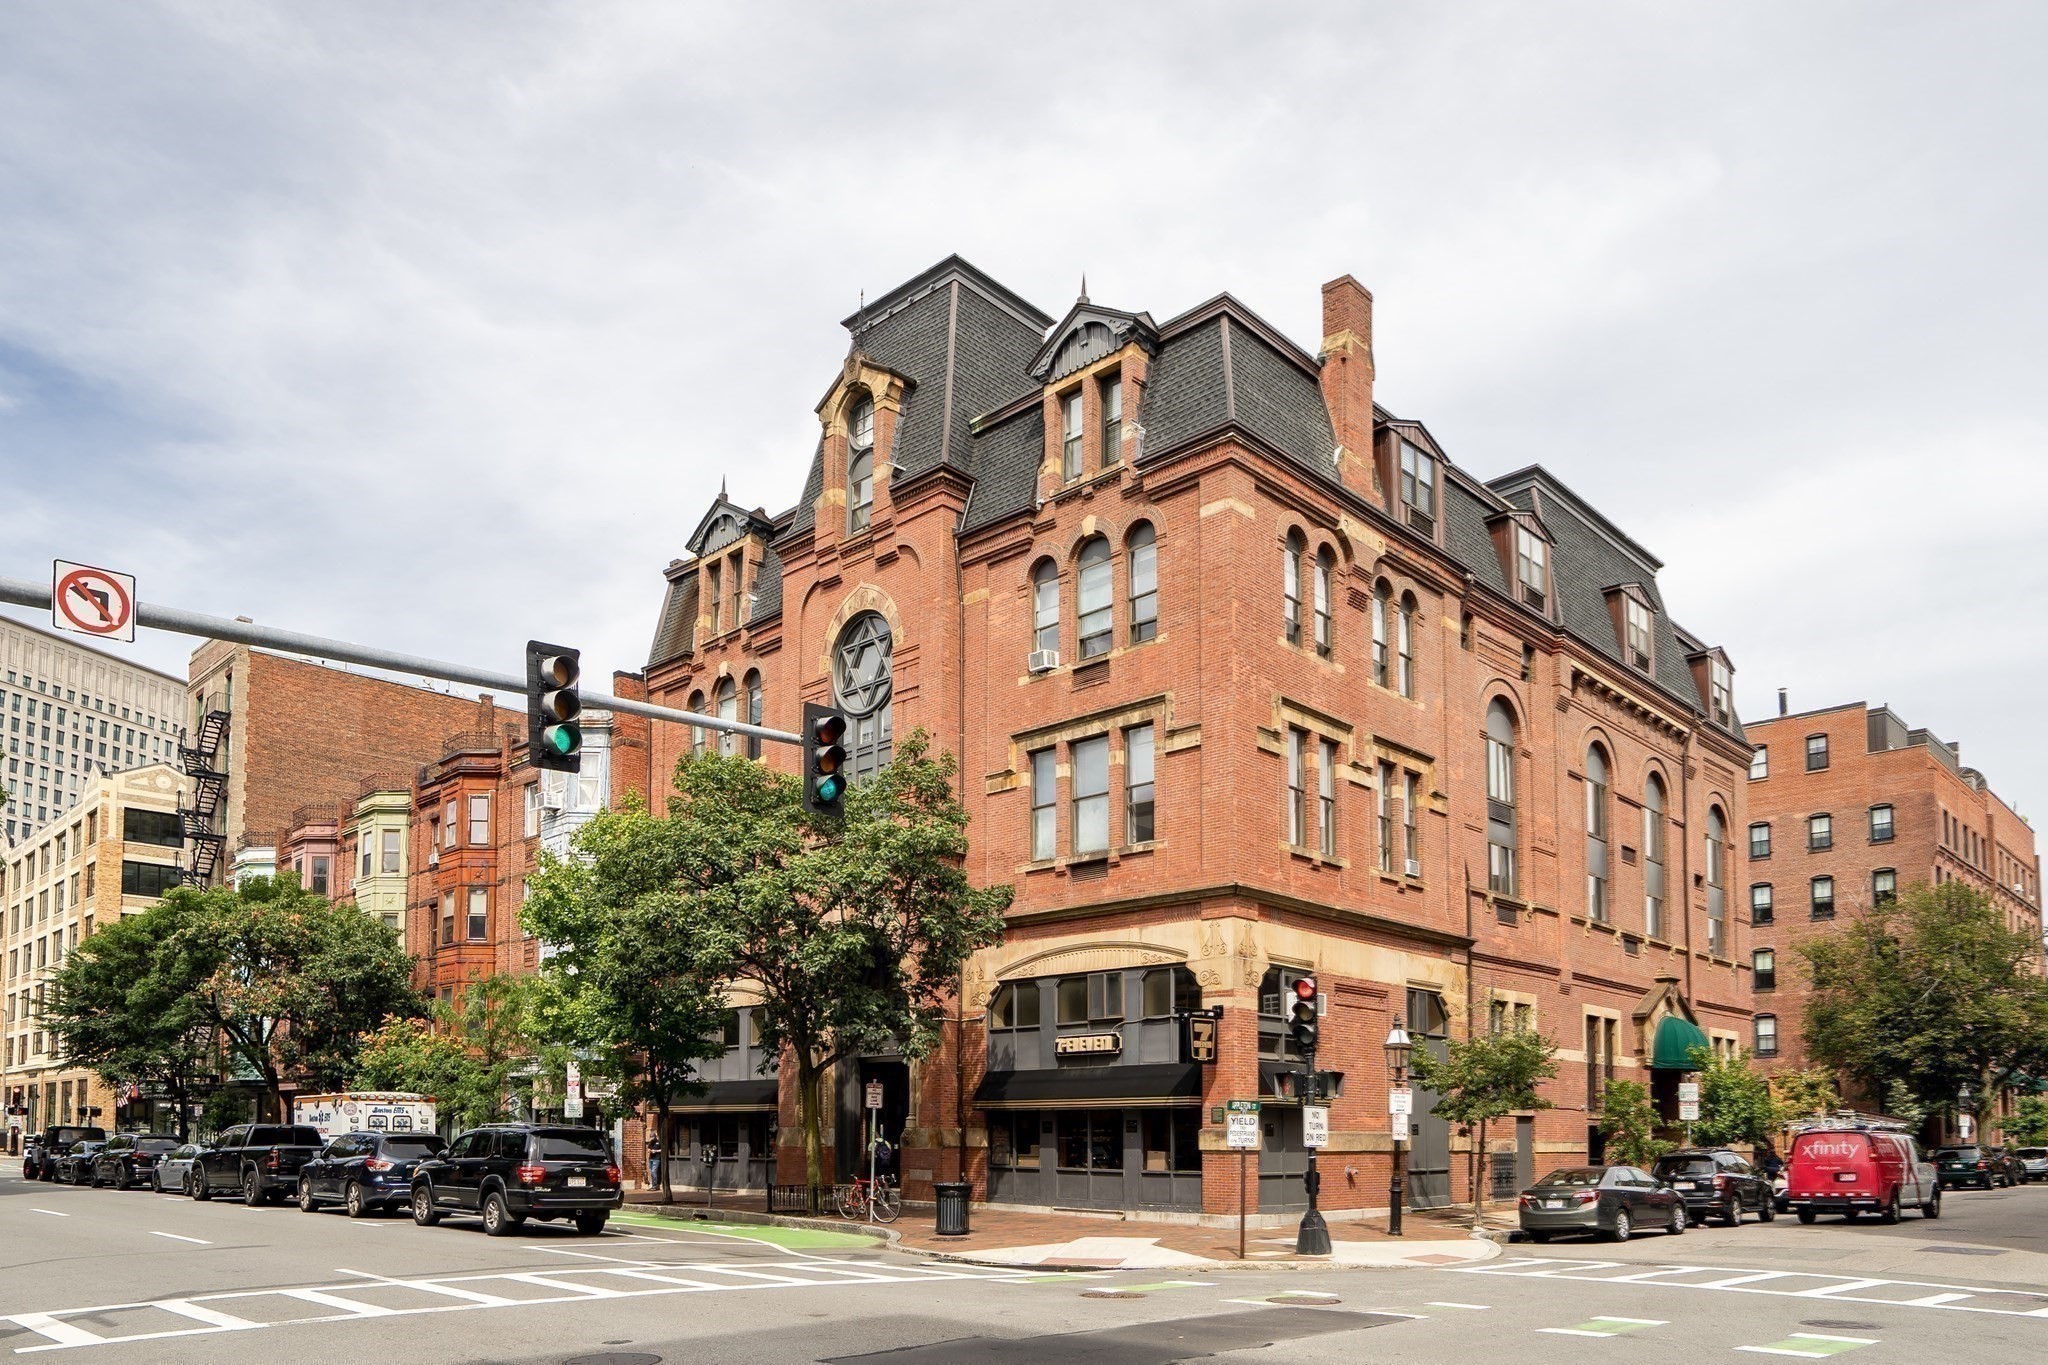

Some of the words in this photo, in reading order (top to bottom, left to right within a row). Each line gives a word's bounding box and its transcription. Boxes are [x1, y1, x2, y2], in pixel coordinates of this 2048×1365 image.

[1193, 1023, 1212, 1058] 7
[372, 1106, 392, 1114] Boston
[393, 1106, 405, 1114] EMS
[1312, 1111, 1319, 1120] NO
[1230, 1117, 1255, 1125] YIELD
[1309, 1122, 1324, 1130] TURN
[1306, 1133, 1314, 1142] ON
[1316, 1134, 1327, 1142] RED
[1801, 1140, 1860, 1159] xfinity
